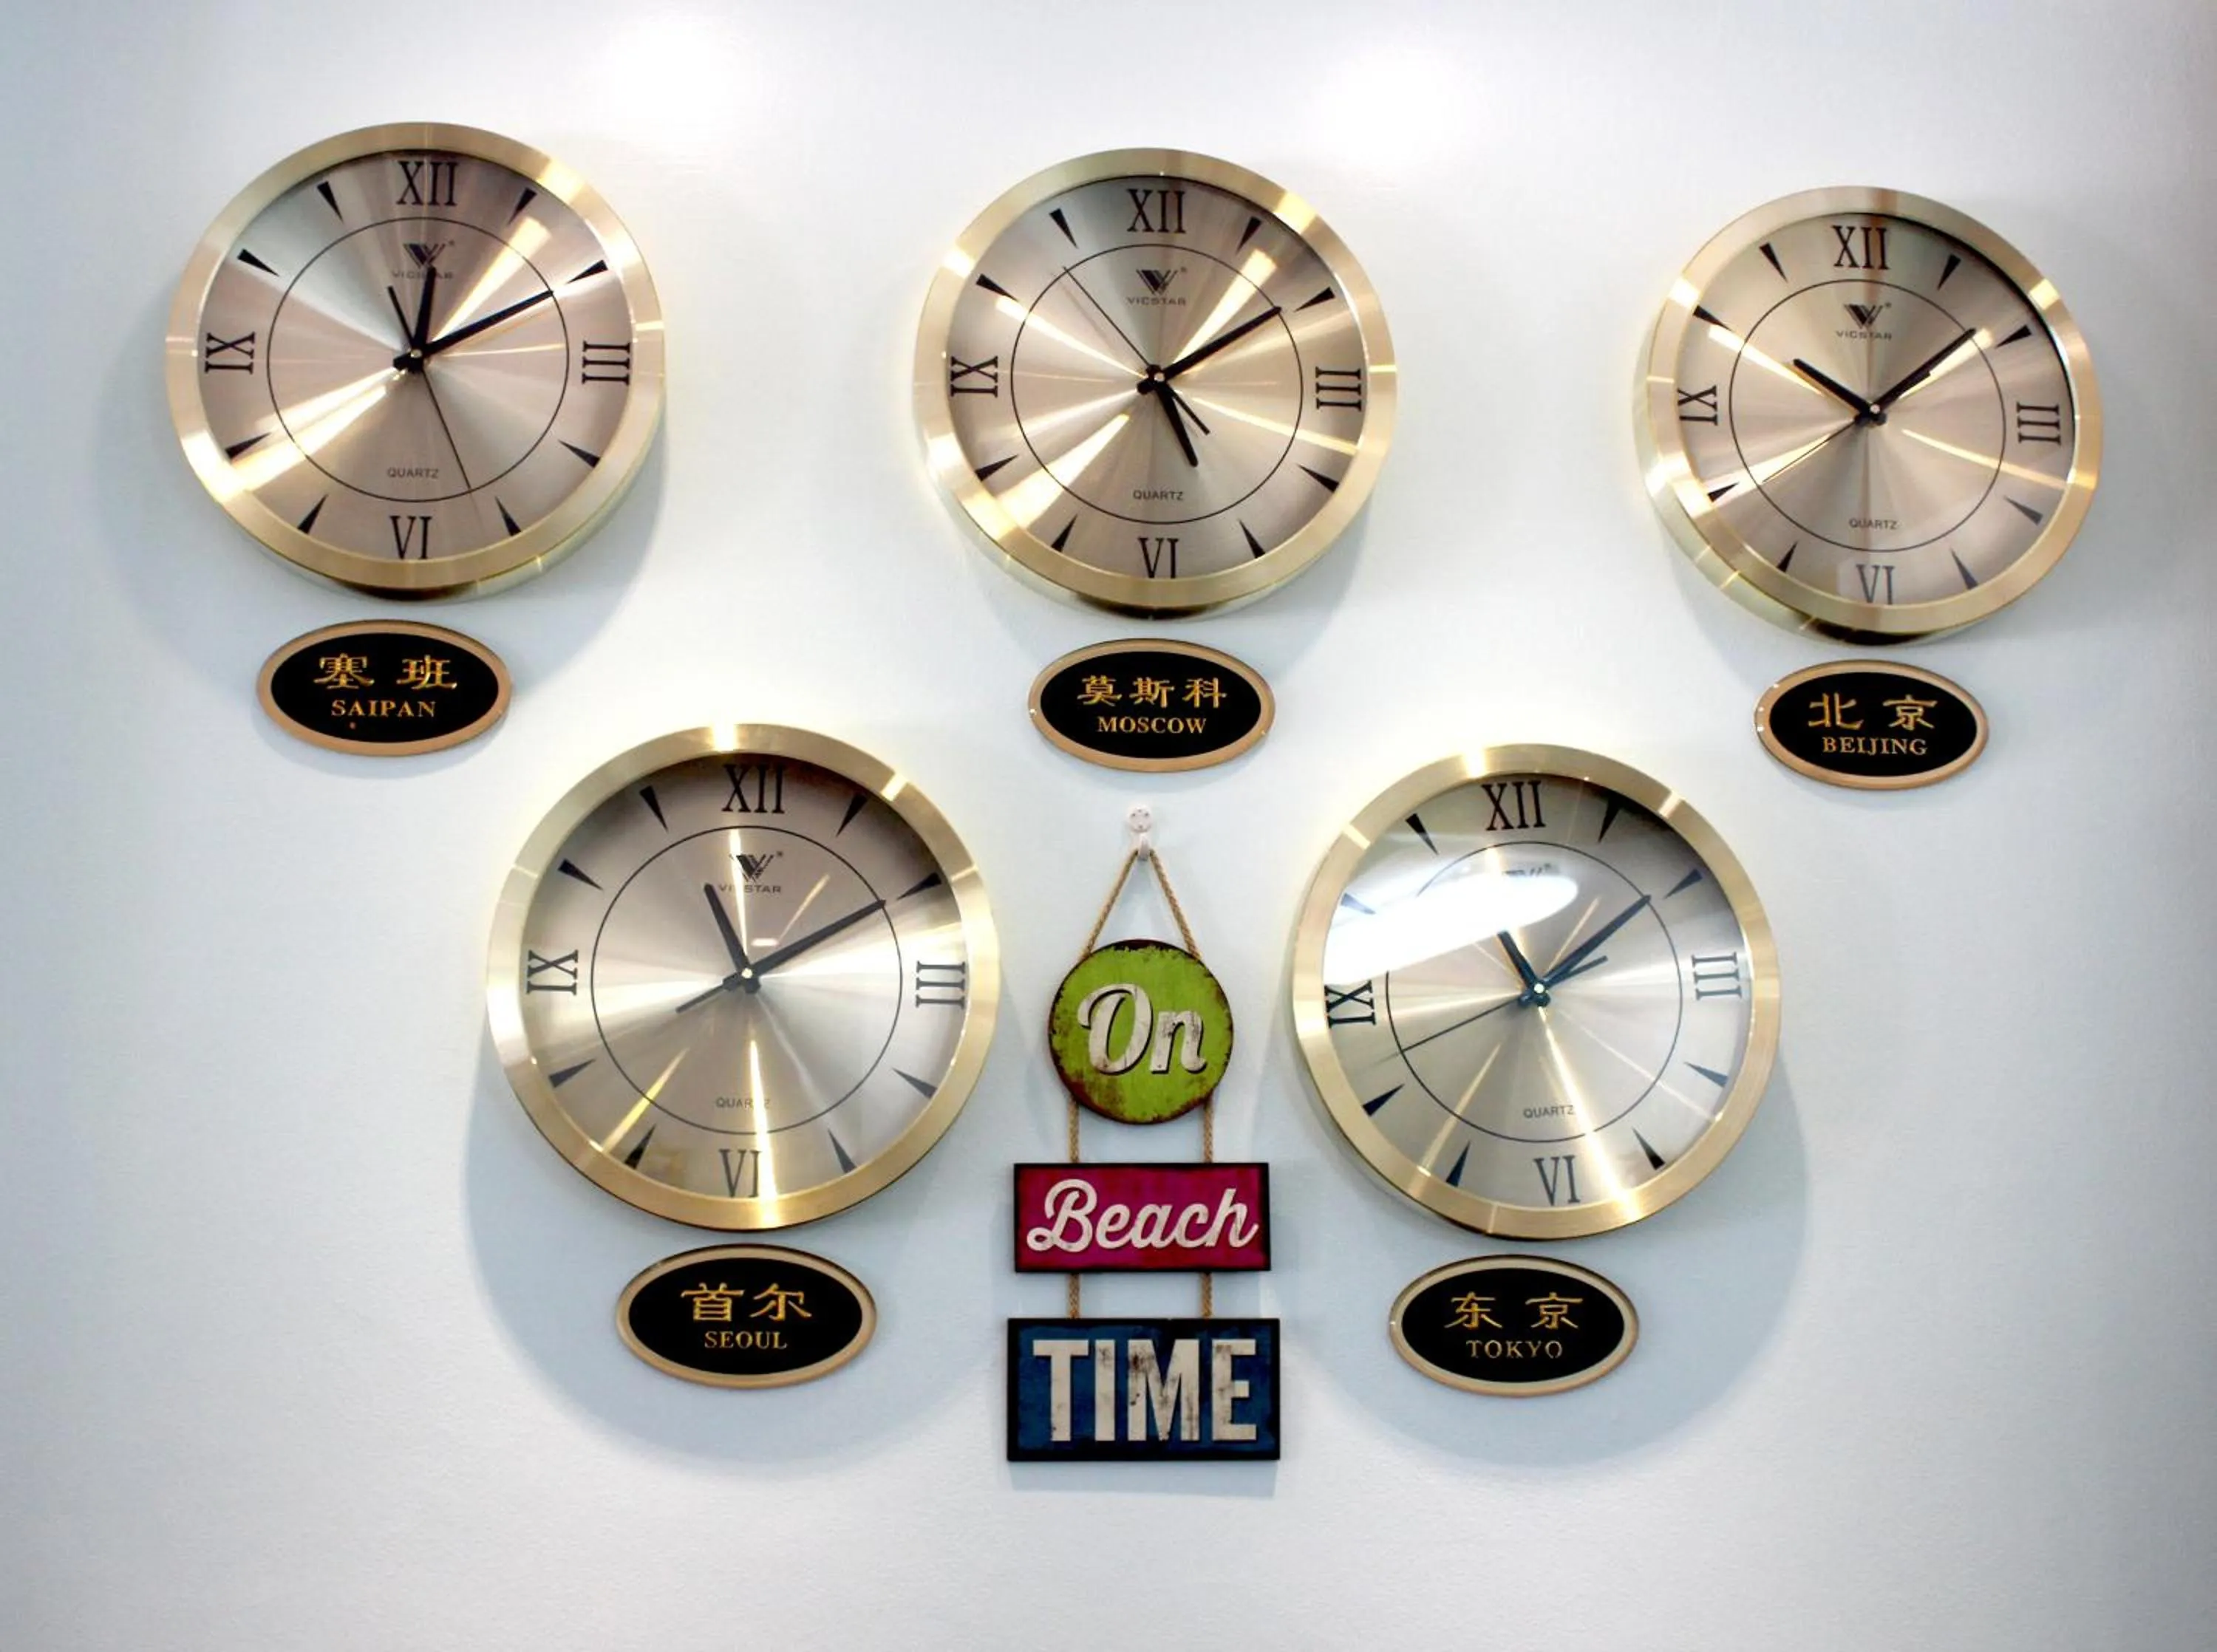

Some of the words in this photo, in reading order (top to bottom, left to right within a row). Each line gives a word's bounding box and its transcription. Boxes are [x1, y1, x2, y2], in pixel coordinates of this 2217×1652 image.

[397, 161, 457, 207] XII
[1127, 189, 1186, 234] XII
[1833, 225, 1890, 270] XII
[1126, 296, 1186, 305] VICSTAR
[205, 332, 256, 373] IX
[1836, 330, 1892, 340] VICSTAR
[581, 340, 630, 386] III
[950, 355, 998, 397] IX
[1315, 366, 1362, 411] III
[1678, 384, 1719, 426] IX
[2016, 401, 2062, 446] III
[387, 467, 439, 479] QUARTZ
[1133, 490, 1183, 501] QUARTZ
[389, 515, 432, 559] VI
[1849, 518, 1898, 530] QUARTZ
[1138, 536, 1179, 578] VI
[1856, 564, 1895, 605] VI
[314, 653, 457, 689] 塞班
[1077, 675, 1227, 708] 莫斯科
[331, 700, 436, 717] SAIPAN
[1097, 716, 1206, 734] MOSCOW
[1808, 692, 1938, 731] 北京
[1822, 737, 1928, 755] BEIJING
[722, 763, 786, 814] XII
[1482, 780, 1546, 831] XII
[719, 884, 781, 892] VISTAR
[527, 949, 579, 995] IX
[916, 961, 966, 1008] III
[1692, 952, 1743, 1000] III
[1324, 980, 1376, 1028] IX
[1077, 983, 1207, 1075] On
[715, 1097, 771, 1108] QUARZ
[1523, 1105, 1574, 1118] QUARTZ
[718, 1148, 761, 1198] VI
[1533, 1155, 1581, 1206] VI
[1026, 1178, 1259, 1252] Beach
[680, 1283, 812, 1322] 首尔
[1444, 1291, 1583, 1328] 东京
[704, 1331, 788, 1349] SEOUL
[1465, 1339, 1563, 1358] TOKYO
[1032, 1339, 1257, 1442] TIME
